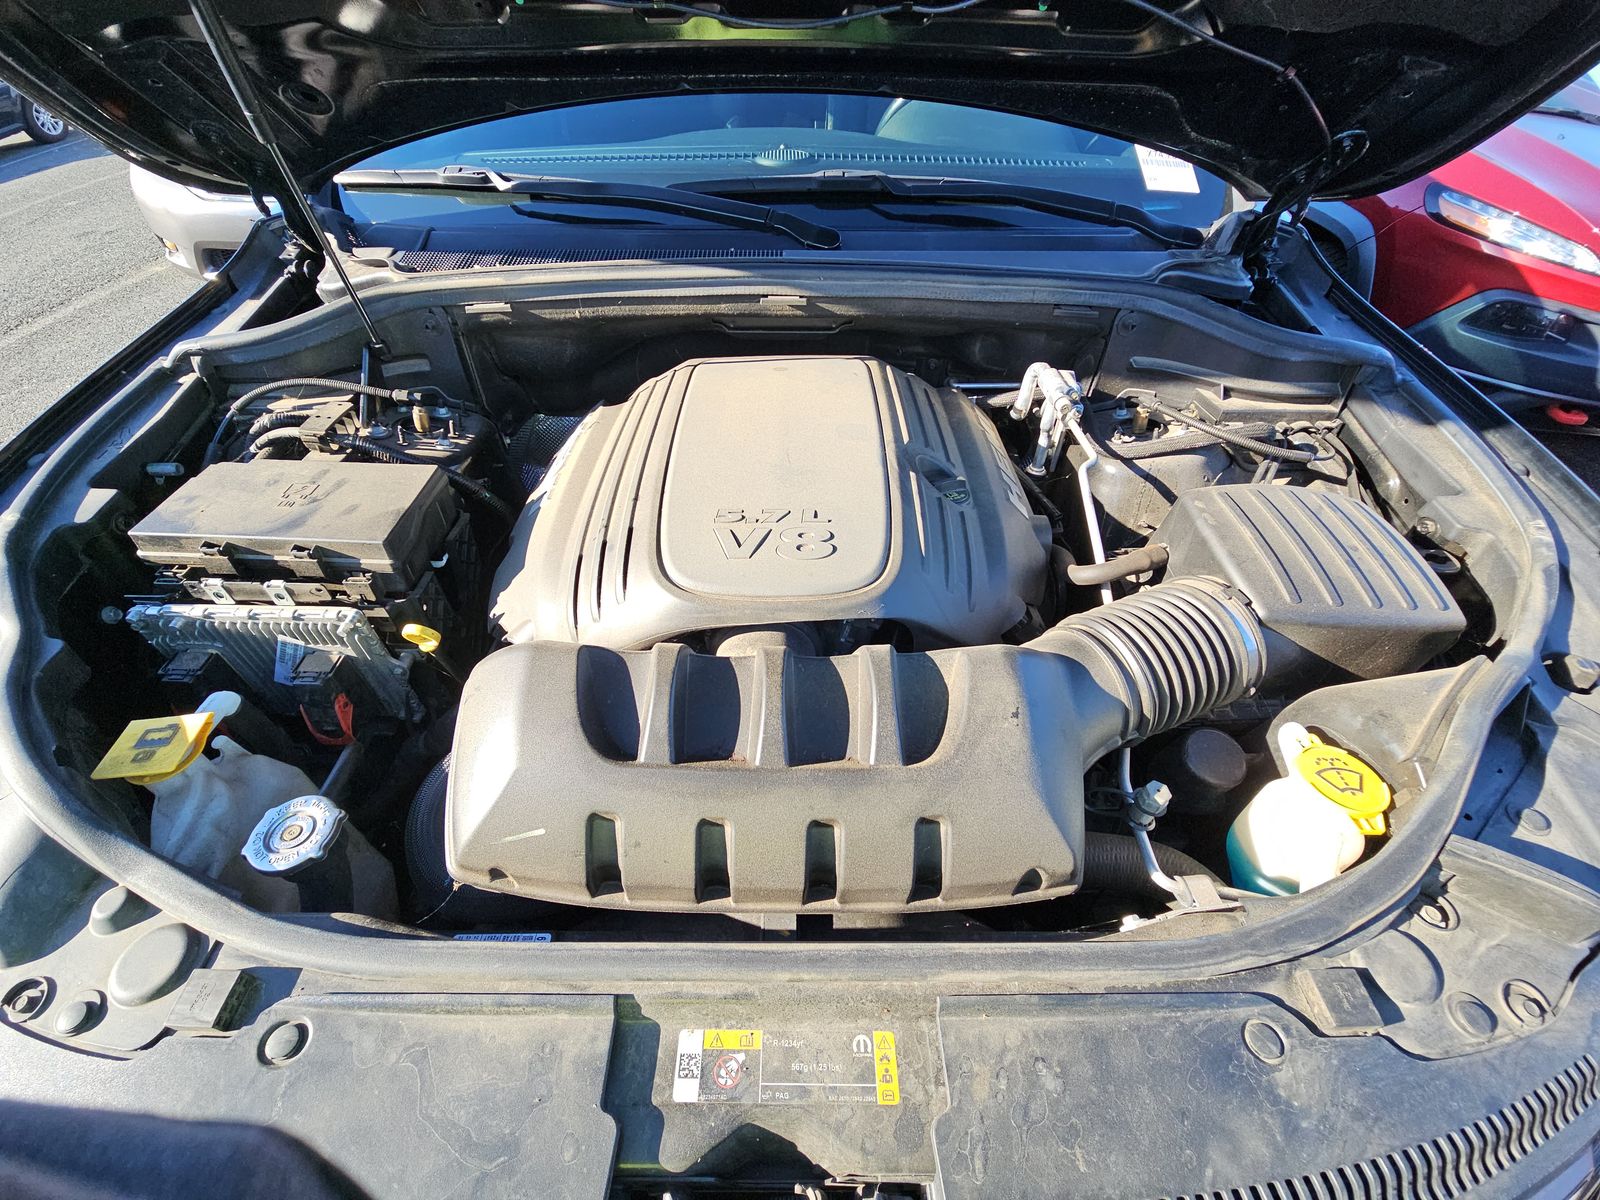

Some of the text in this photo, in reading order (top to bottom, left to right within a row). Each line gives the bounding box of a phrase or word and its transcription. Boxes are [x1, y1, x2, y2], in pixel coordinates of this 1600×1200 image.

[712, 527, 838, 560] V8
[773, 1039, 804, 1049] R-1234yf
[791, 1062, 809, 1073] 567g
[775, 1091, 790, 1100] PAG
